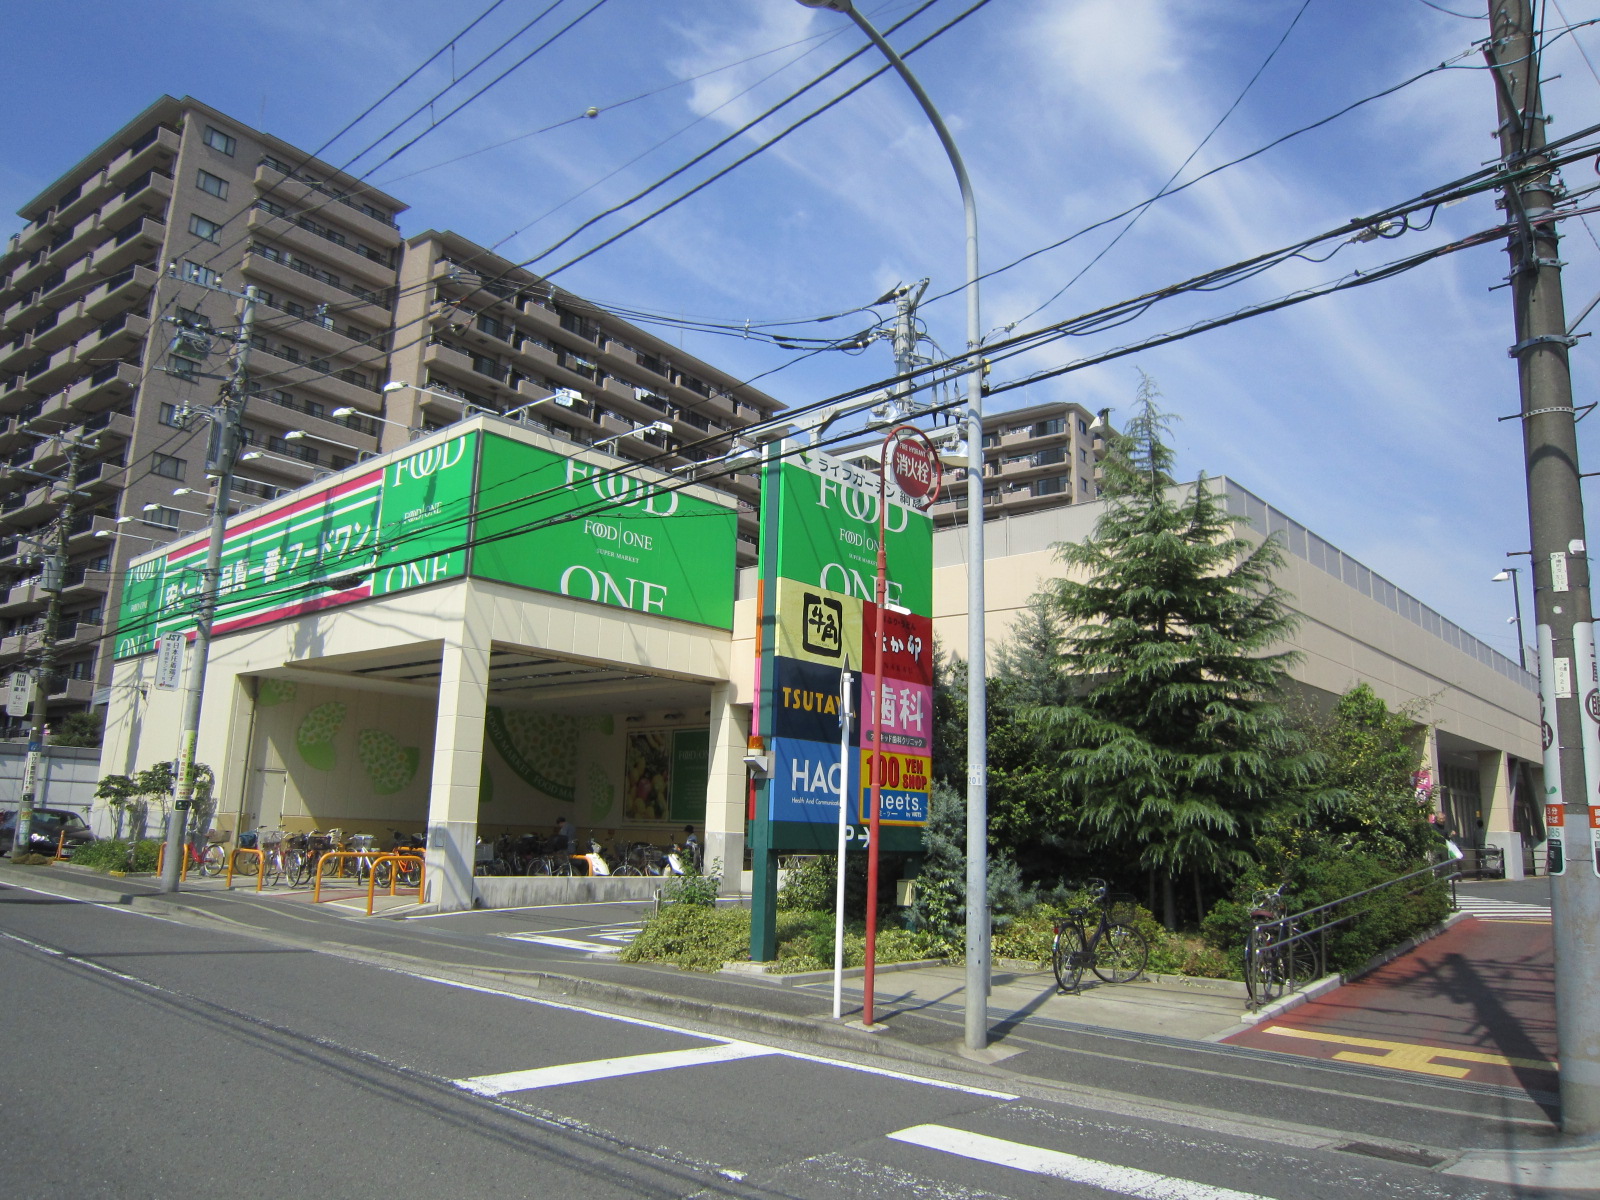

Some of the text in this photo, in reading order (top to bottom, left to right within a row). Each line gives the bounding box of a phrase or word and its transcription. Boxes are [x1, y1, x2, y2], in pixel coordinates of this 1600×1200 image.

[393, 435, 466, 487] FOOD
[899, 443, 926, 457] FIRE HYDRANT
[896, 452, 929, 484] 消火栓
[565, 458, 678, 517] FOOD
[816, 477, 907, 533] FOOD
[583, 519, 653, 551] FOOD ONE
[839, 528, 863, 547] FOOD
[596, 548, 640, 564] SUPER MARKET
[560, 565, 668, 612] ONE
[166, 633, 181, 641] JST
[808, 605, 837, 644] 牛角
[782, 686, 857, 718] TSUTA
[870, 683, 924, 732] 歯科
[533, 775, 559, 794] FOOD
[866, 754, 923, 788] 100 YEN
[902, 773, 927, 790] SHOP
